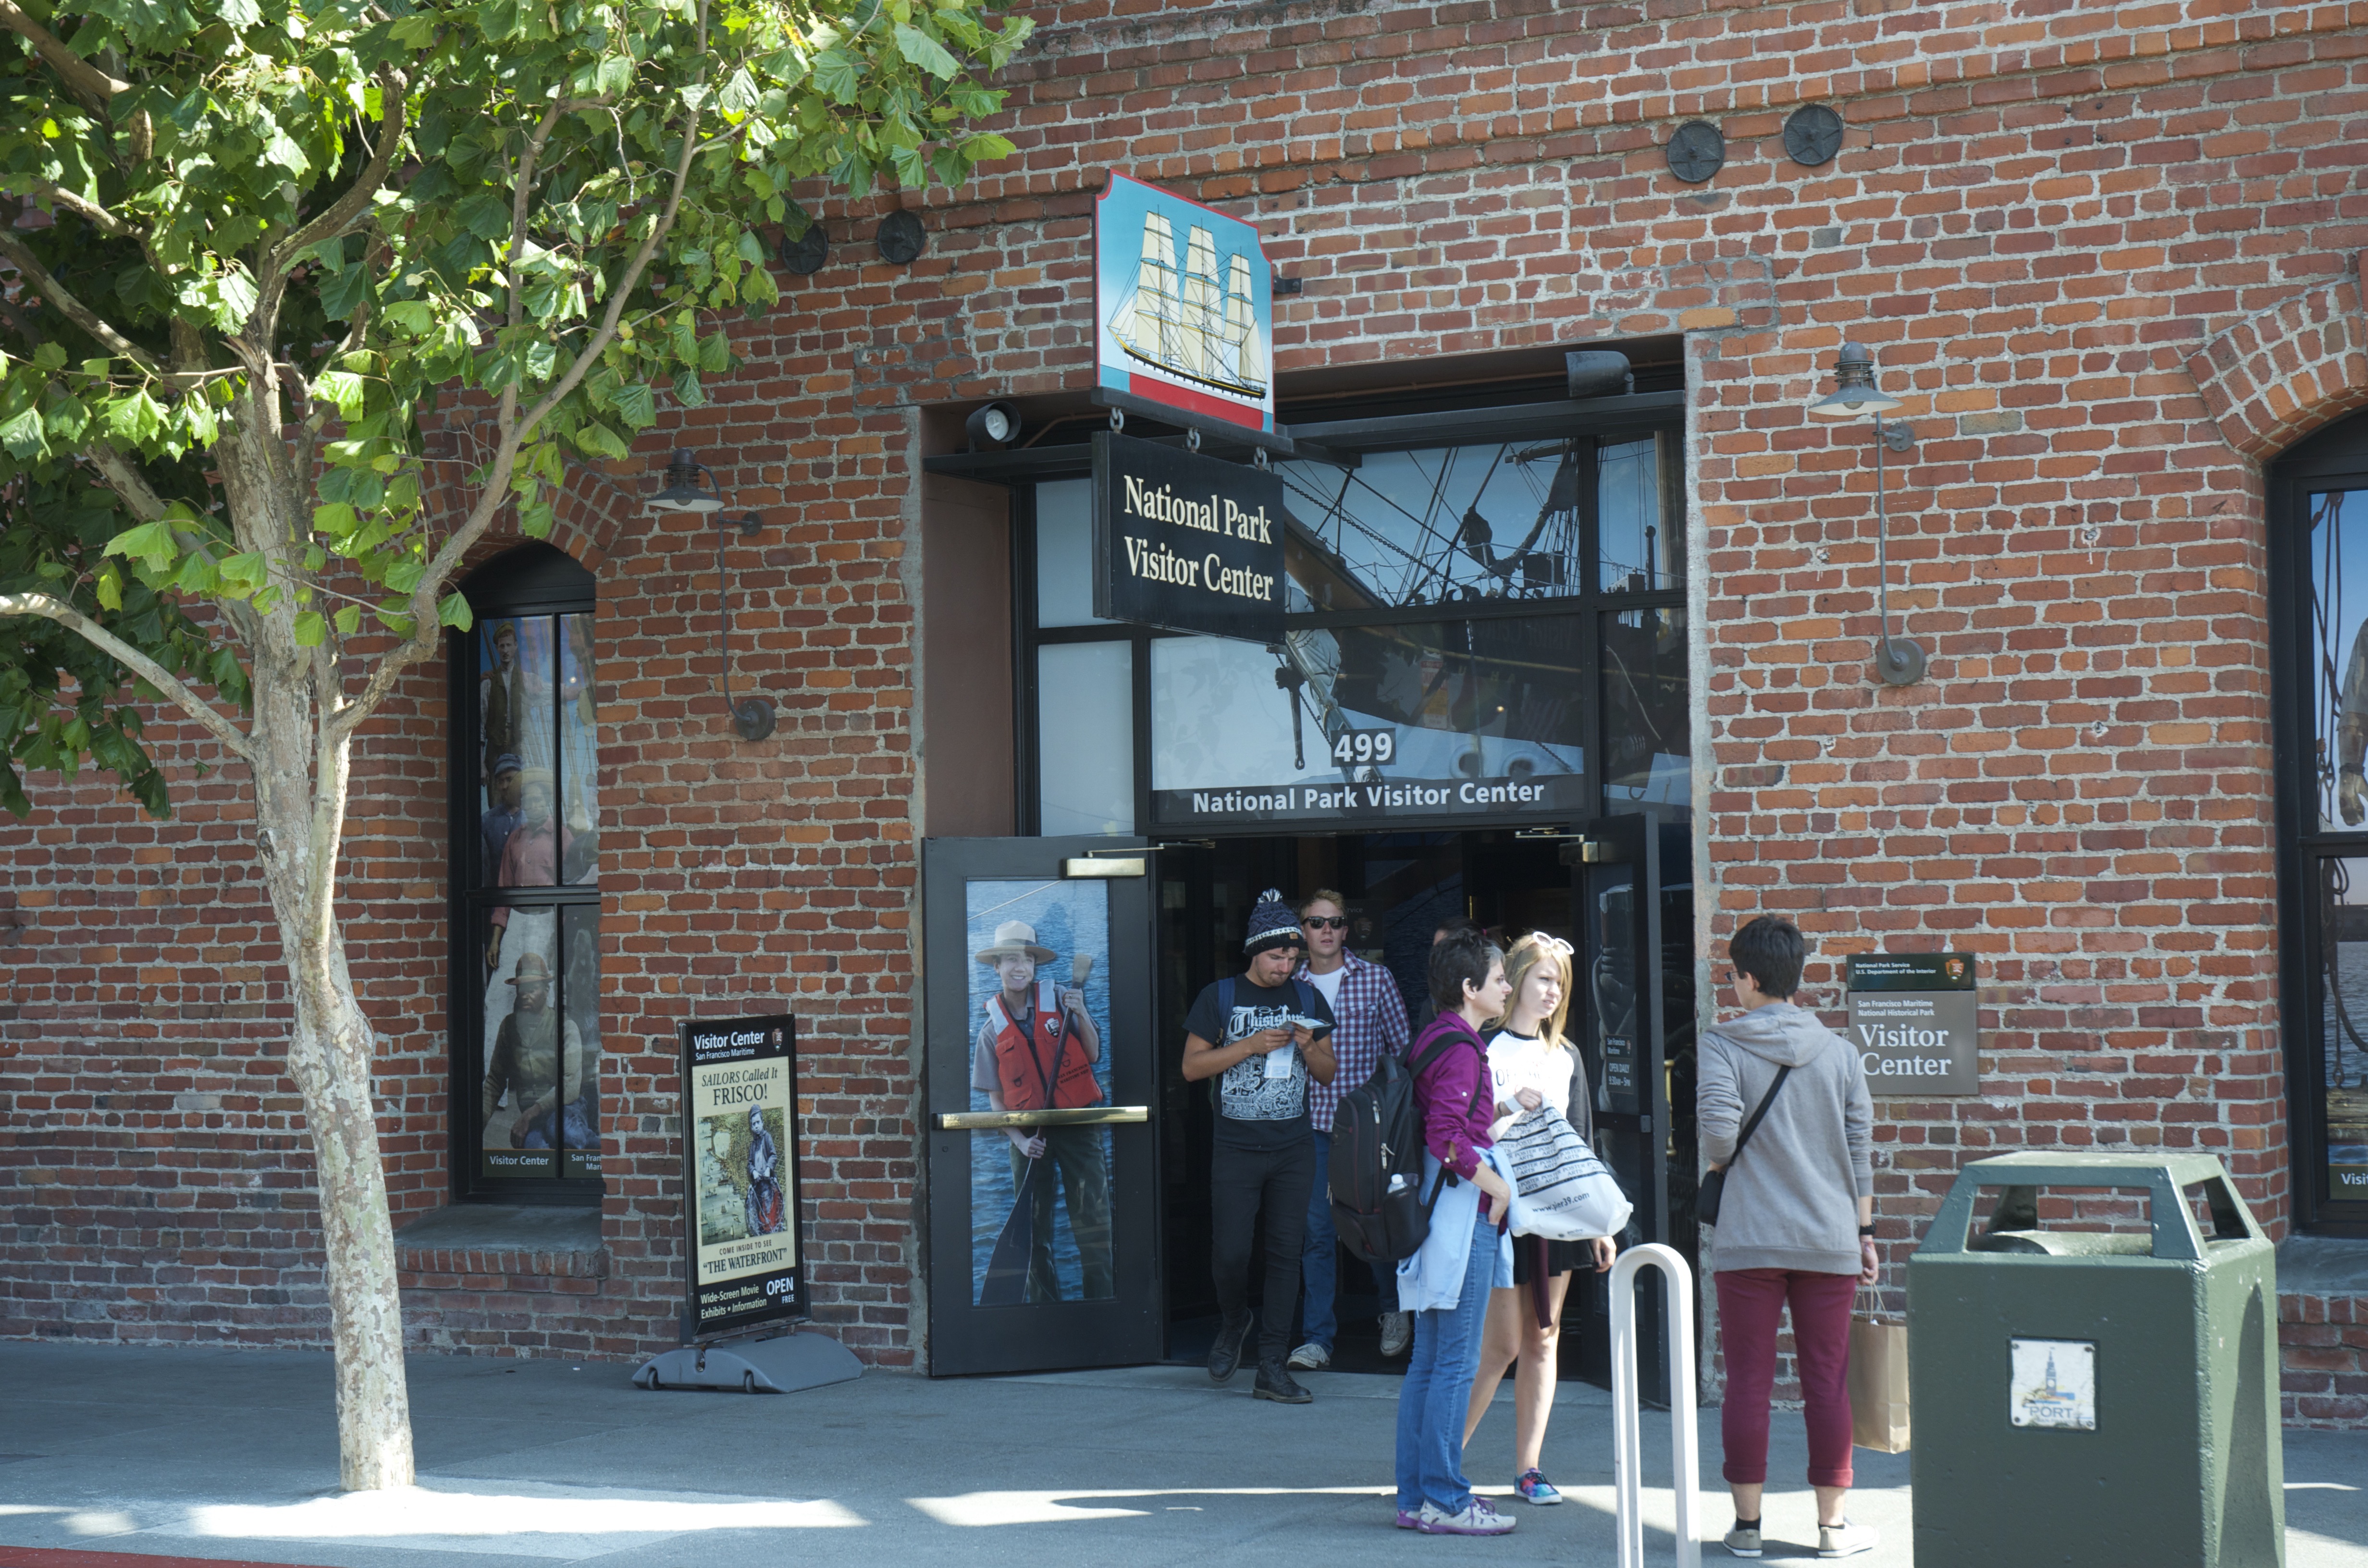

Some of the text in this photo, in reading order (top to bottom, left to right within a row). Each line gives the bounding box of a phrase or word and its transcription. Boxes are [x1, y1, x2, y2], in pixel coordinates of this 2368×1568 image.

[1123, 475, 1272, 544] National Park
[1124, 536, 1274, 601] Visitor Center
[1334, 733, 1393, 763] 499
[1193, 779, 1545, 813] National Park Visitor Center
[694, 1034, 728, 1050] Visitor
[730, 1030, 765, 1047] Center
[1857, 1023, 1949, 1047] Visitor
[696, 1047, 755, 1061] San Francisco Maritime
[1859, 1052, 1952, 1076] Center
[702, 1066, 778, 1087] SAILORS Called It
[1609, 1063, 1630, 1073] OPEN DAILY
[713, 1083, 768, 1106] FRISCO!
[490, 1155, 549, 1165] Visitor Center
[1532, 1193, 1590, 1212] www.pier39.com
[719, 1247, 735, 1255] COME
[736, 1243, 753, 1252] INSIDE
[700, 1284, 759, 1305] Wide-Screen Movie
[766, 1276, 794, 1296] OPEN
[701, 1298, 767, 1320] Exhibits Information
[781, 1294, 794, 1304] FREE
[2029, 1407, 2073, 1419] PORT
